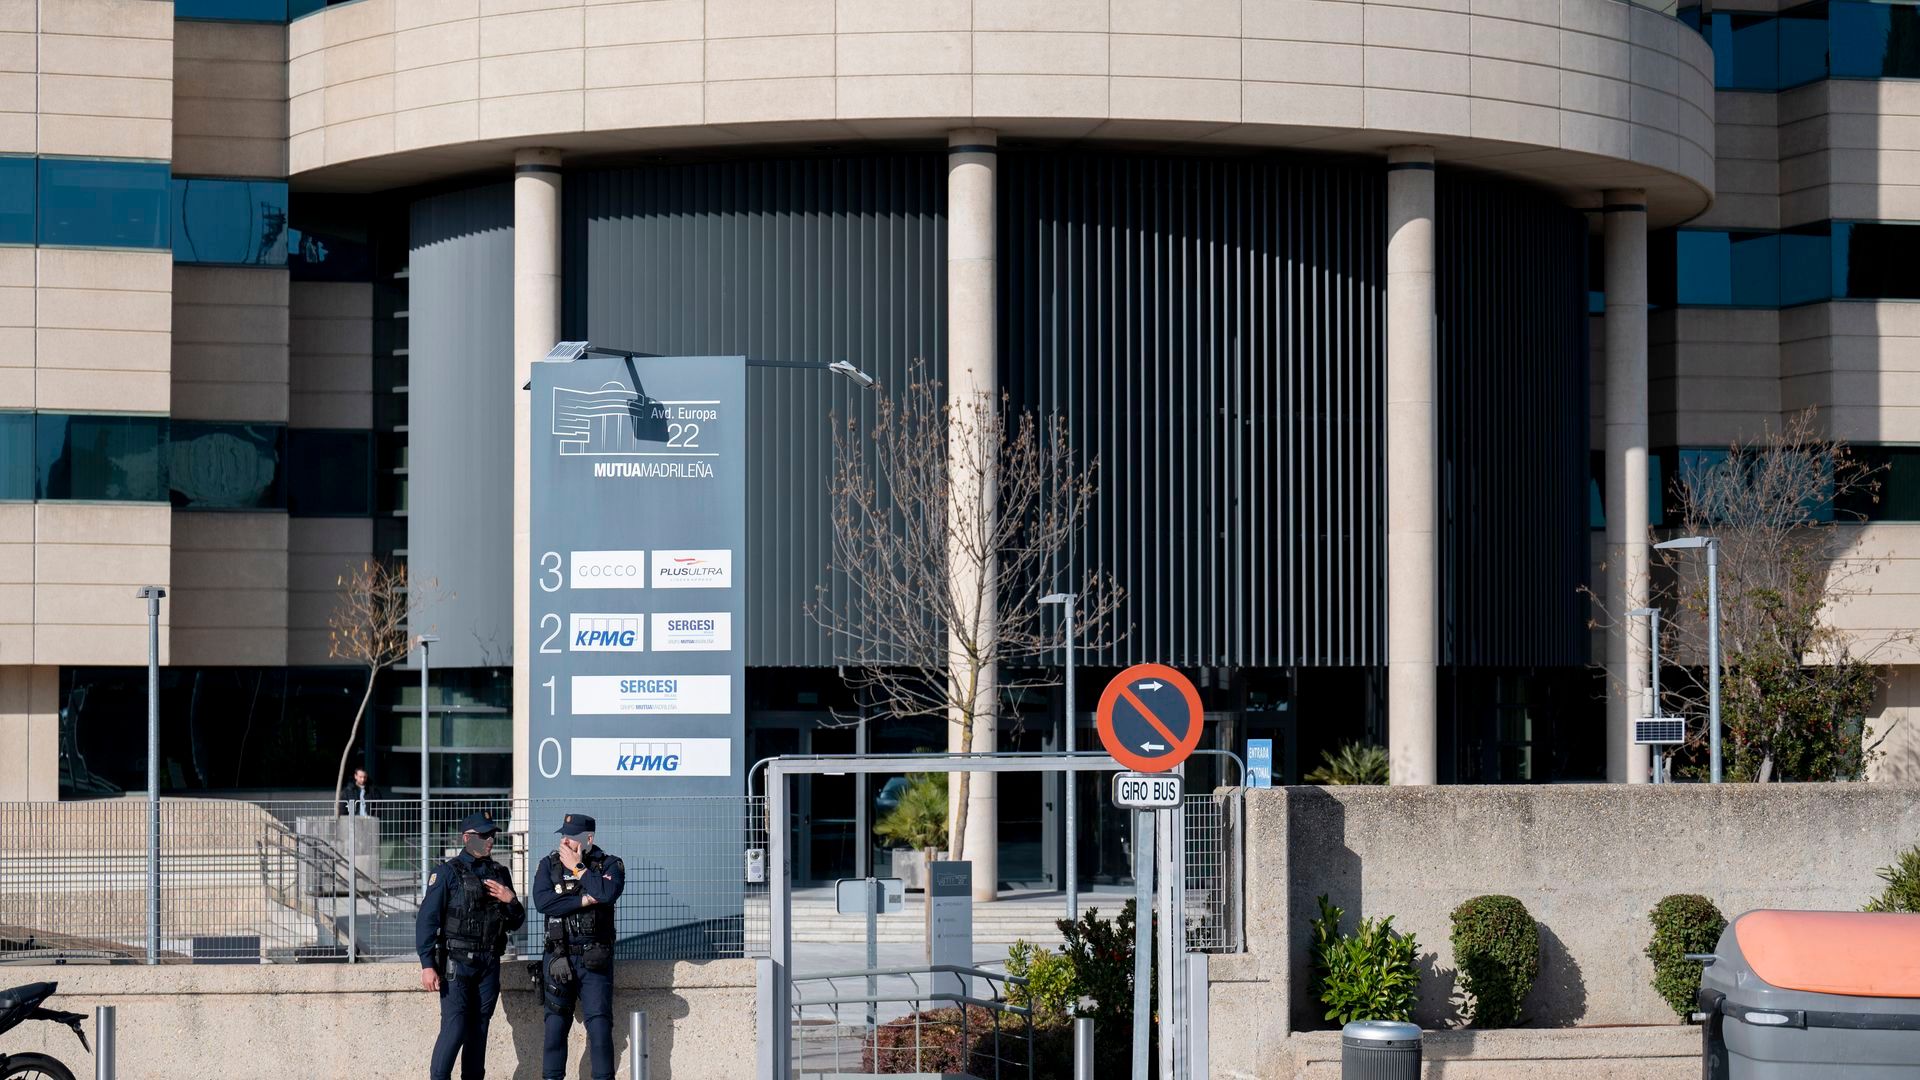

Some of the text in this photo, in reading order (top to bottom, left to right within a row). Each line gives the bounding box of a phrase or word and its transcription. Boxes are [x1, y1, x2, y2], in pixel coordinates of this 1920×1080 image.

[651, 407, 717, 422] Avd. Europa
[666, 423, 700, 448] 22
[594, 460, 714, 478] MUTUAMADRILEÑA
[539, 551, 563, 592] 3
[579, 565, 637, 577] GOCCO
[660, 567, 723, 576] PLUSULTRA
[539, 613, 562, 653] 2
[668, 619, 715, 631] SERGESI
[575, 630, 635, 647] KPMG
[620, 679, 678, 693] SERGESI
[542, 675, 555, 716] 1
[538, 737, 562, 779] 0
[1249, 746, 1270, 759] ENTRADA
[616, 754, 679, 771] KPMG
[1122, 781, 1176, 801] GIRO BUS
